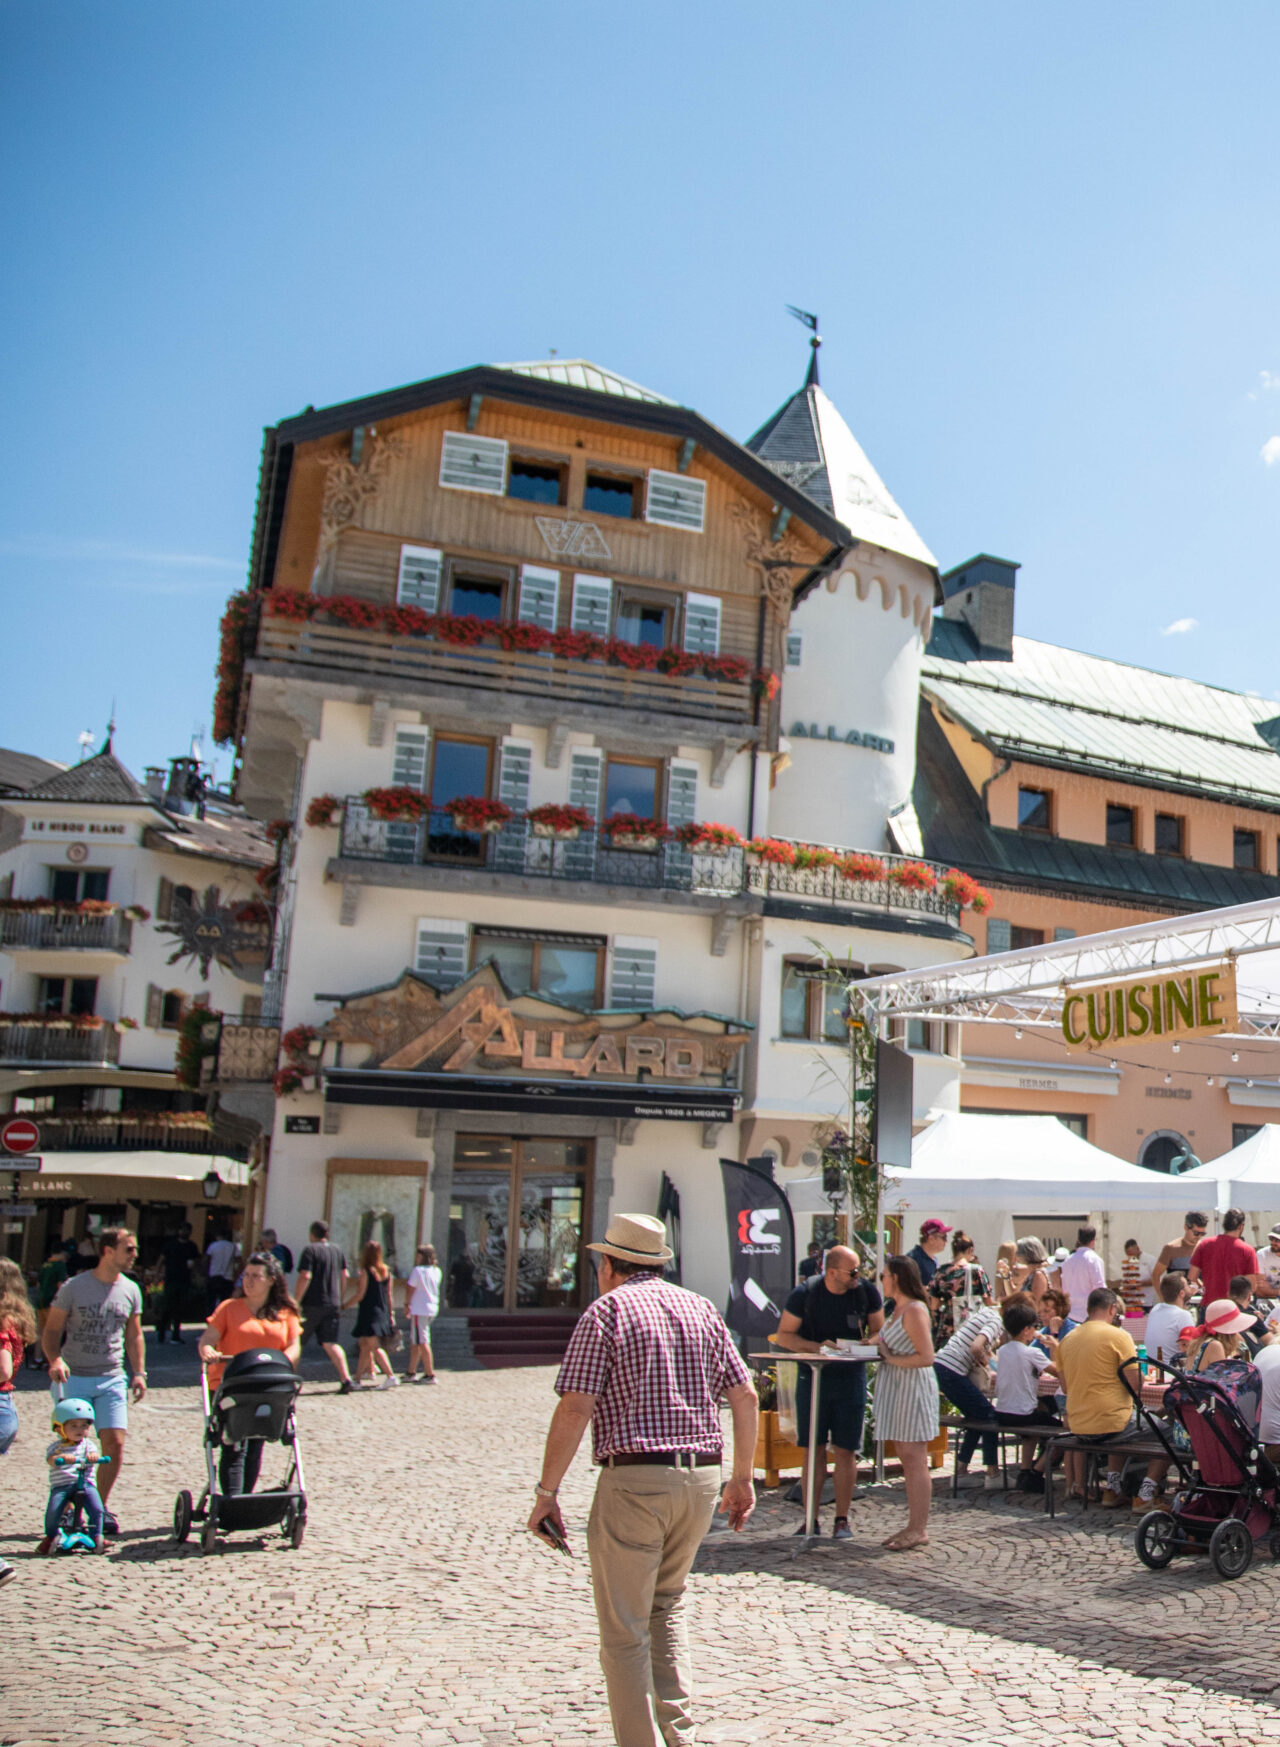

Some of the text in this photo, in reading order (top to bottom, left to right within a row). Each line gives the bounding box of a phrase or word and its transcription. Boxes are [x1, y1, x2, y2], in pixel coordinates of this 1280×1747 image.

[780, 721, 895, 755] ALLARD
[31, 821, 126, 834] LE HIBOU BLANC
[1062, 973, 1226, 1044] CUISINE
[634, 1106, 663, 1116] Depuis
[32, 1181, 73, 1191] BLANC
